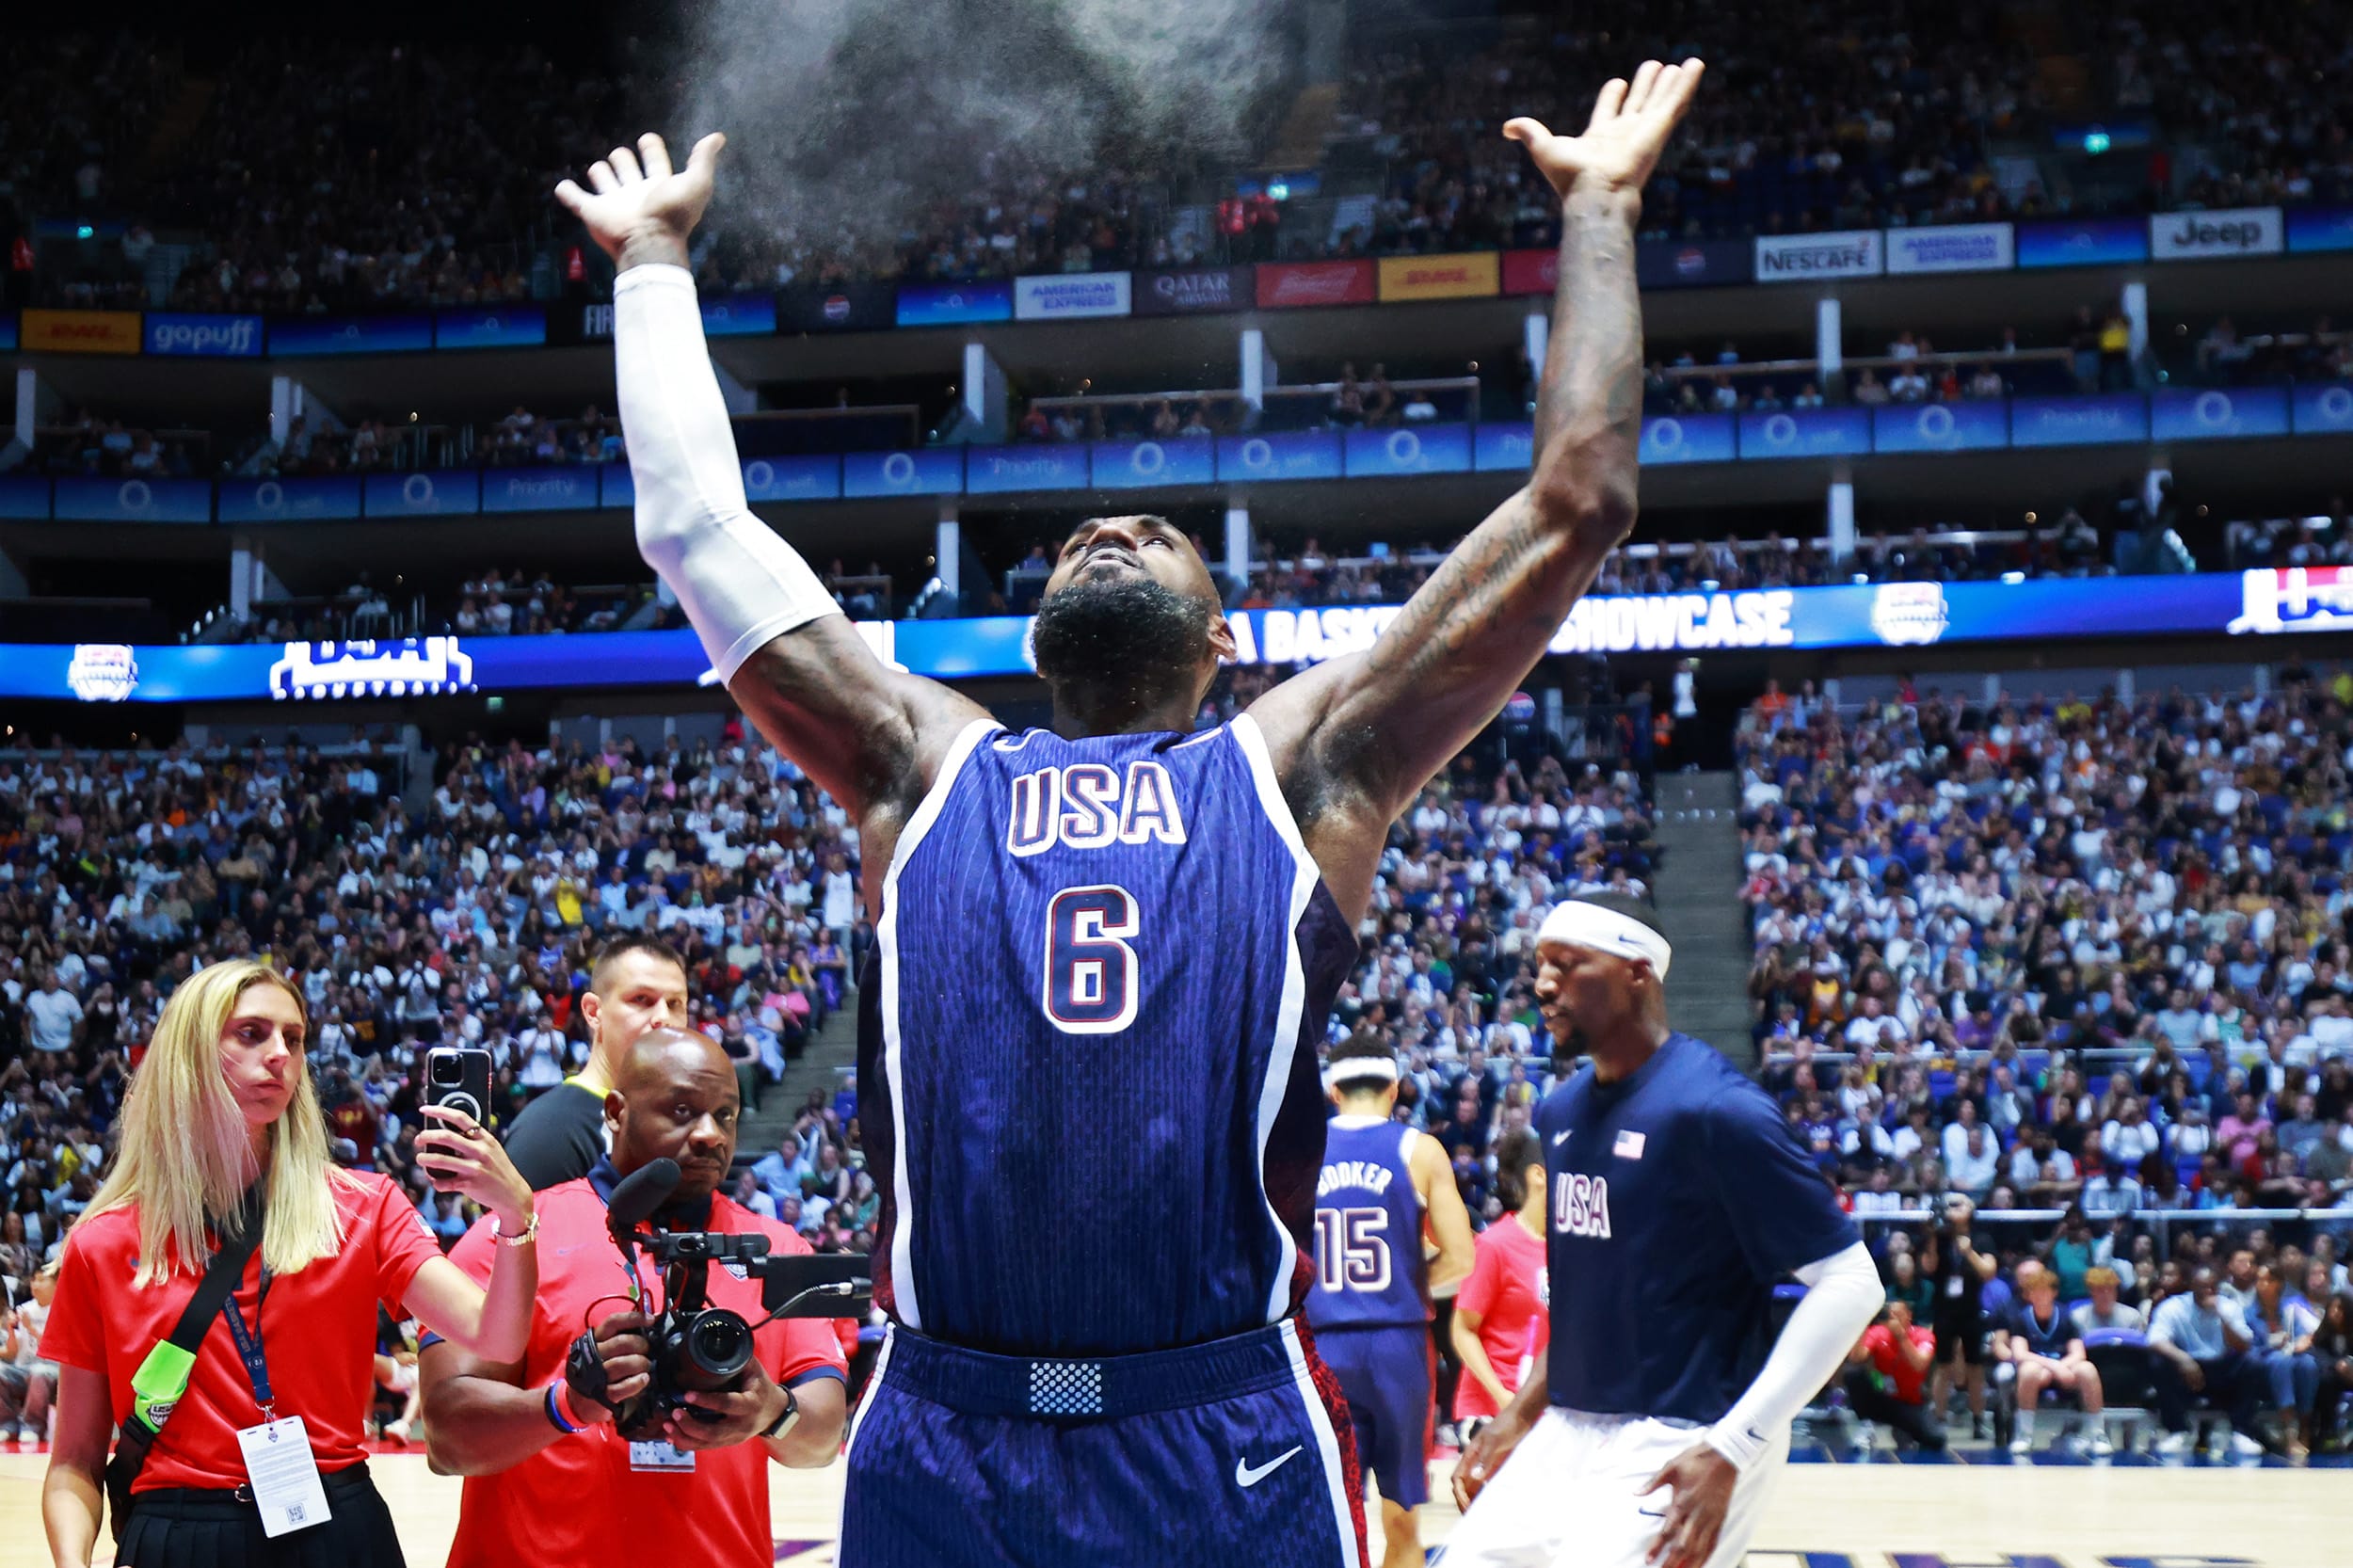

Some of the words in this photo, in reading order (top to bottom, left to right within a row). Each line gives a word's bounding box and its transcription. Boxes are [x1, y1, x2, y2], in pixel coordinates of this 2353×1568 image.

[2173, 216, 2262, 248] Jeep
[1031, 280, 1117, 297] AMERICAN
[1155, 272, 1230, 297] QATAR
[584, 303, 615, 335] FIA
[1043, 295, 1118, 311] EXPRESS
[153, 318, 255, 351] gopuff
[507, 476, 576, 499] Priority
[1263, 607, 1403, 663] BASK
[1547, 590, 1795, 654] SHOWCASE
[1007, 760, 1187, 857] USA
[1042, 884, 1140, 1034] 6
[1555, 1172, 1612, 1240] USA
[1314, 1206, 1392, 1293] 15
